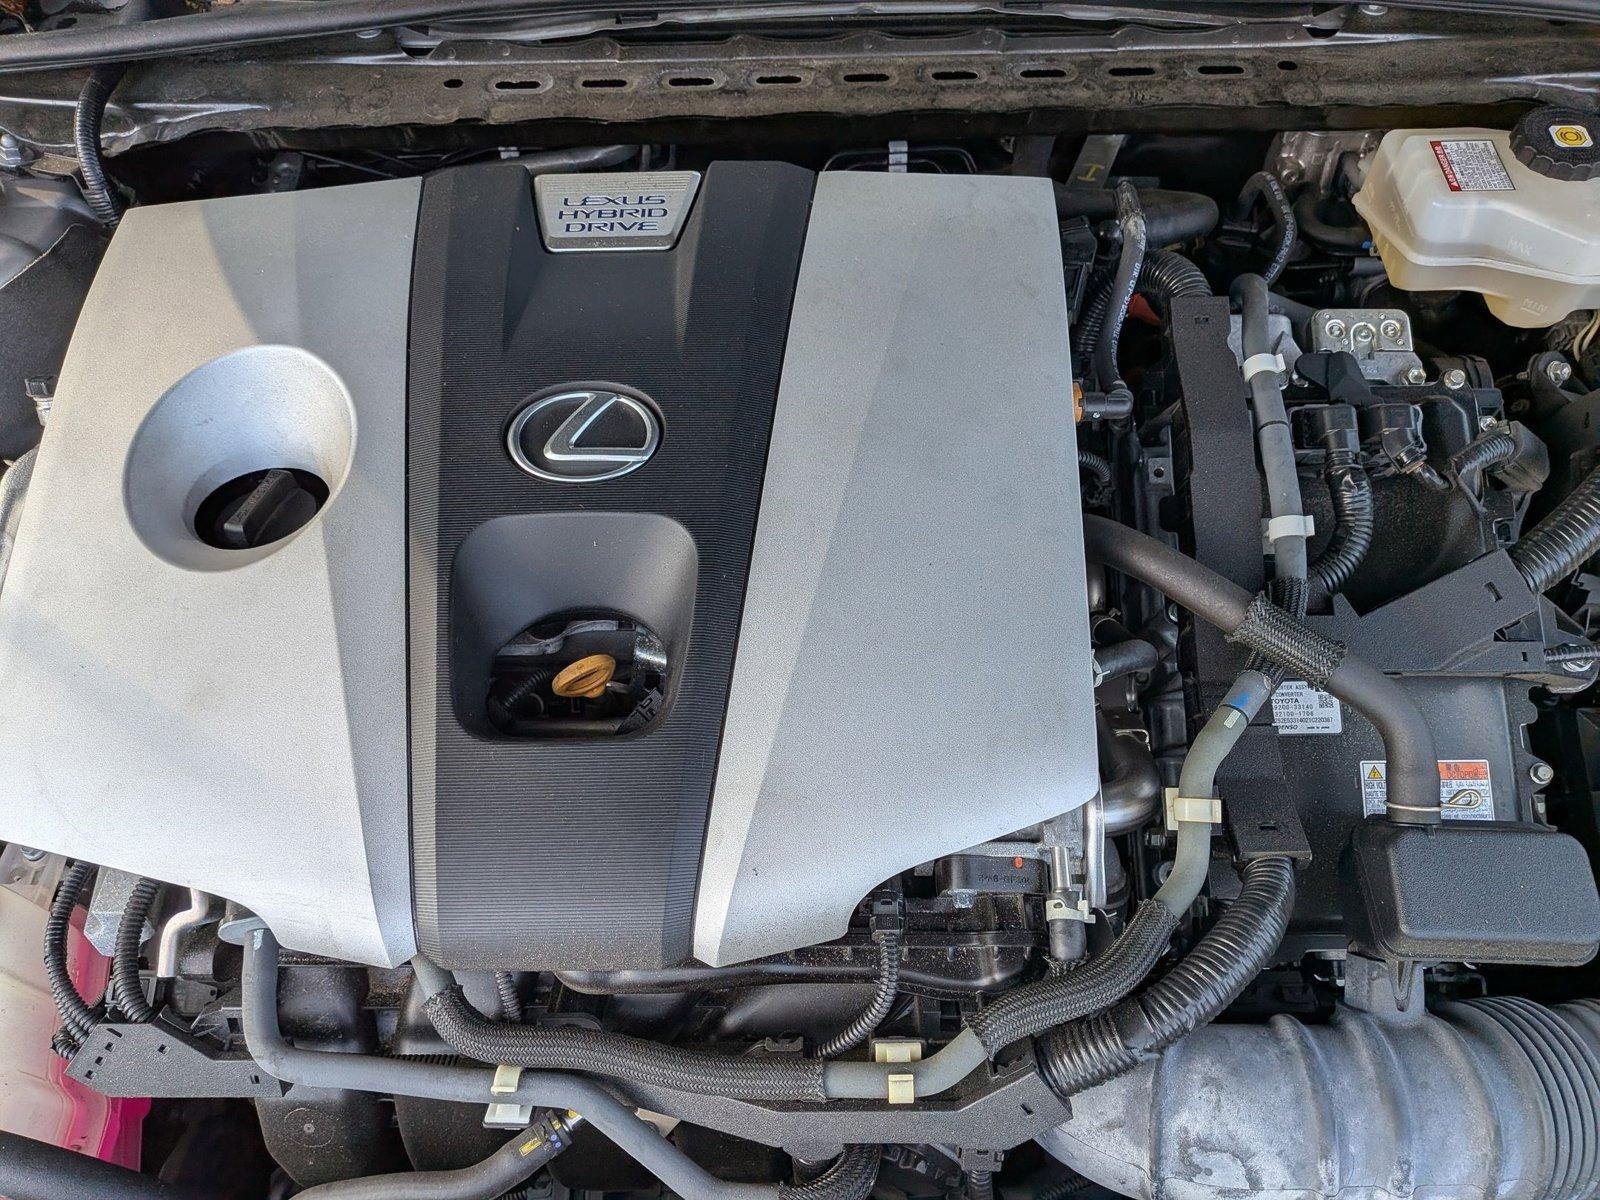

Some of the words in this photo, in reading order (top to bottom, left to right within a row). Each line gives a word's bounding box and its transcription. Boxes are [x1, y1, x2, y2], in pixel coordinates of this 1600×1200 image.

[563, 195, 666, 207] LEXUS
[558, 207, 668, 219] HYBRID
[564, 221, 659, 233] DRIVE
